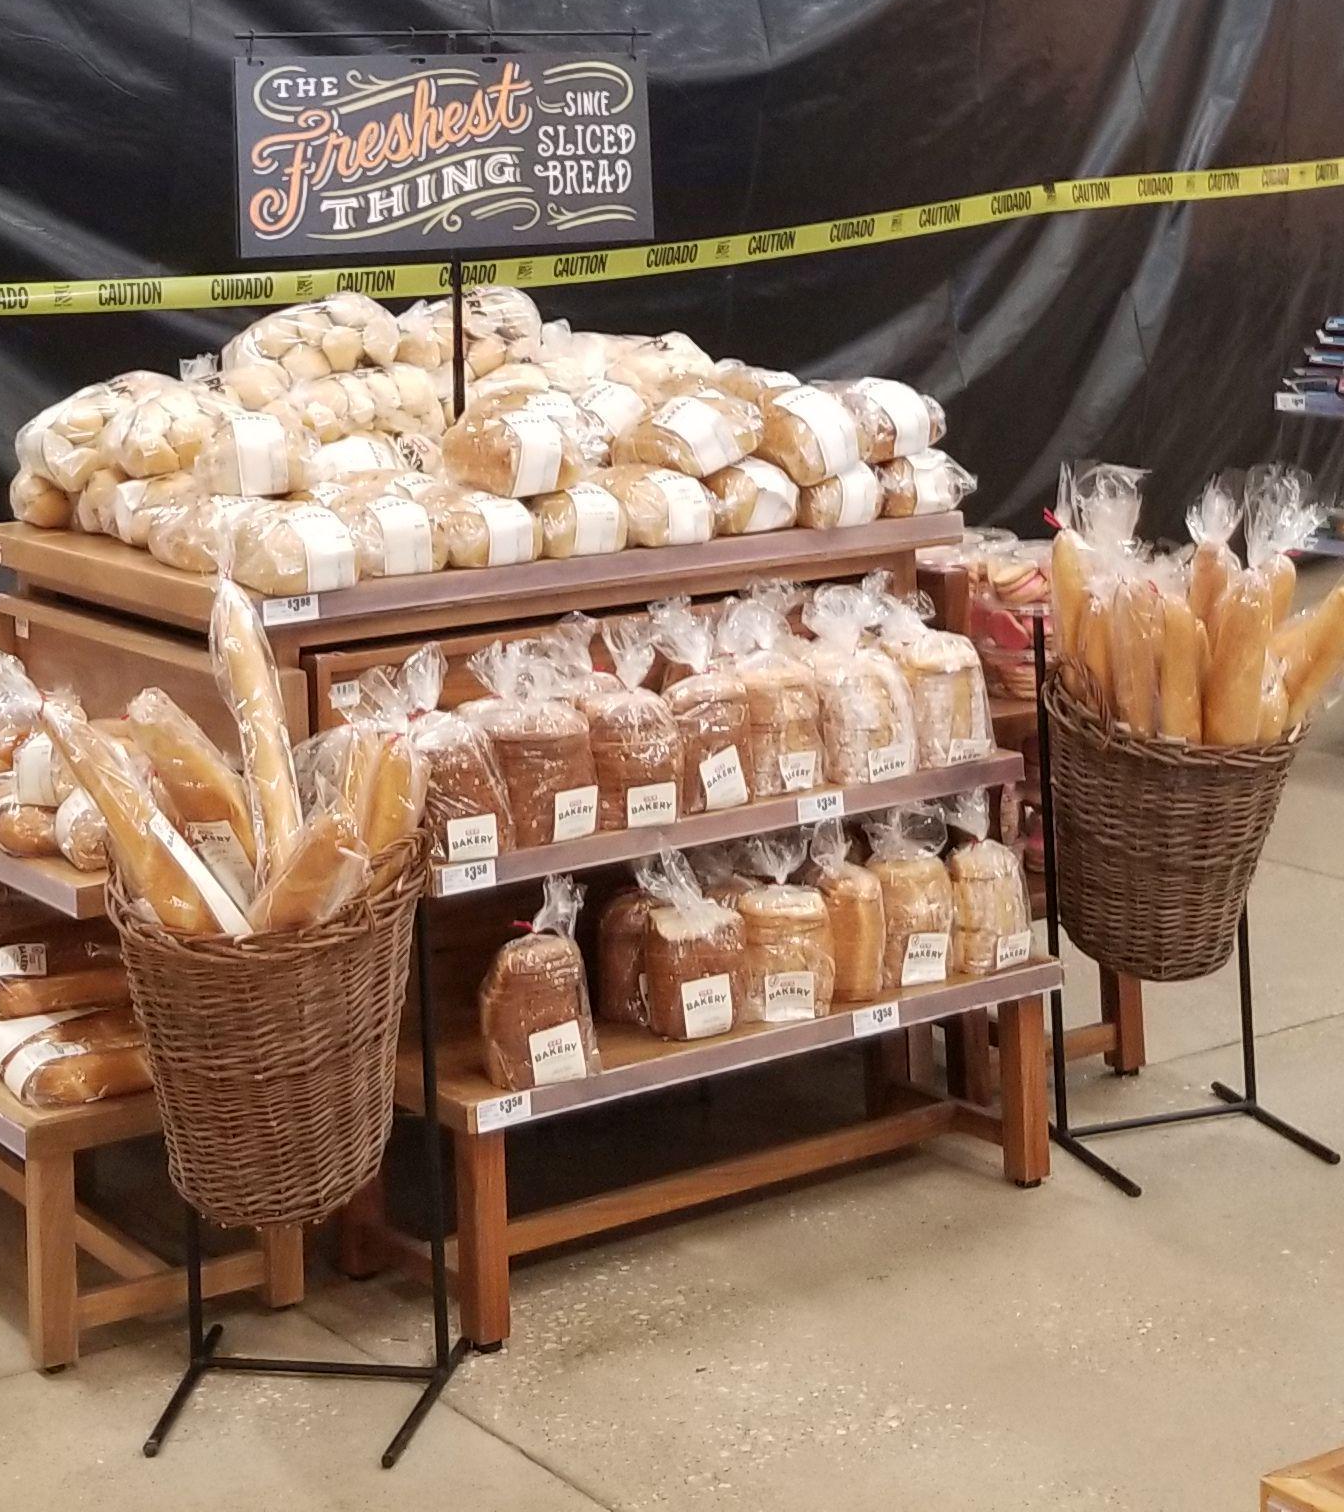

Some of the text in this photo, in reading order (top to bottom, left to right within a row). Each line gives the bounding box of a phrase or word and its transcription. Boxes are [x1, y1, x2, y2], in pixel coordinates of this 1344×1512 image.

[273, 77, 339, 98] THE
[565, 91, 611, 117] SINCE
[250, 62, 534, 236] Freshest
[537, 125, 637, 157] SLICED
[534, 159, 632, 195] BREAD
[321, 154, 522, 231] THING
[98, 281, 162, 306] CAUTION
[211, 276, 274, 301] CUIDADO
[337, 269, 396, 293] CAUTION
[439, 263, 497, 287] CUDADO
[553, 254, 609, 278] CAUTION
[646, 243, 699, 268] CUIDADO
[747, 230, 797, 255] CAUTION
[830, 217, 875, 243] CUIDADO
[918, 202, 962, 228] CAUTION
[991, 190, 1032, 216] CUIDADO
[1071, 180, 1111, 204] CAUTION
[1137, 176, 1174, 197] CUIDADO
[1207, 171, 1240, 192] CAUTION
[706, 766, 737, 790] BAKERY
[872, 760, 906, 776] BAKERY
[558, 804, 594, 820] BAKERY
[631, 800, 673, 815] BAKERY
[452, 834, 494, 850] BAKERY
[908, 950, 944, 960] BAKERY
[686, 993, 728, 1011] BAKERY
[769, 986, 811, 1001] BAKERY
[534, 1042, 578, 1063] BAKERY
